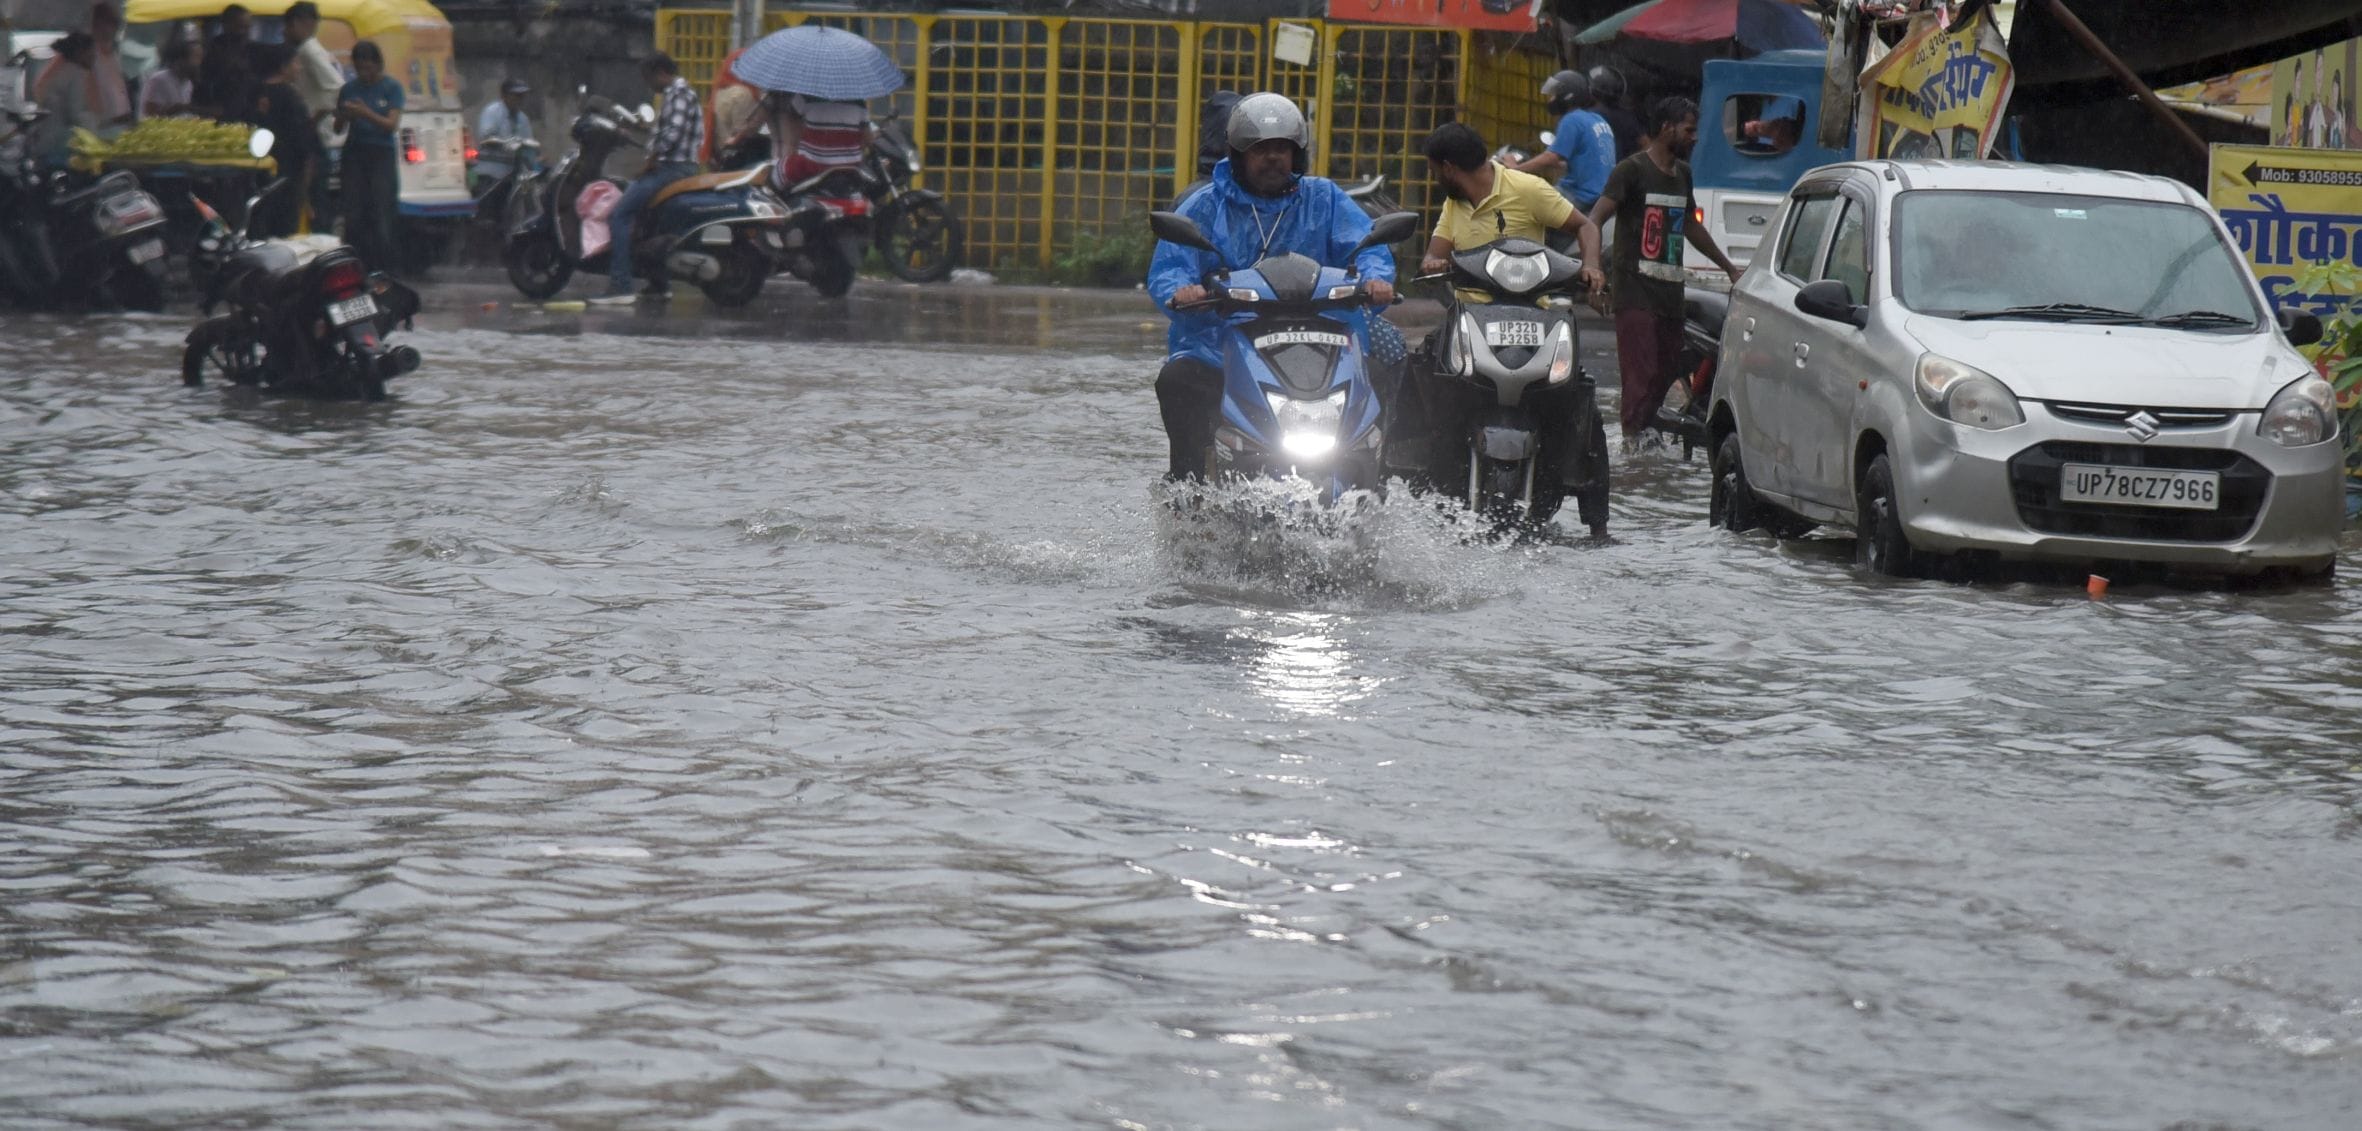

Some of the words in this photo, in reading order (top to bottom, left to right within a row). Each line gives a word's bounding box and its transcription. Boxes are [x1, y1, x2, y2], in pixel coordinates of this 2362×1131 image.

[2260, 168, 2296, 182] Mob:
[2219, 193, 2362, 267] शौक
[2076, 472, 2214, 502] UP78CZ7966
